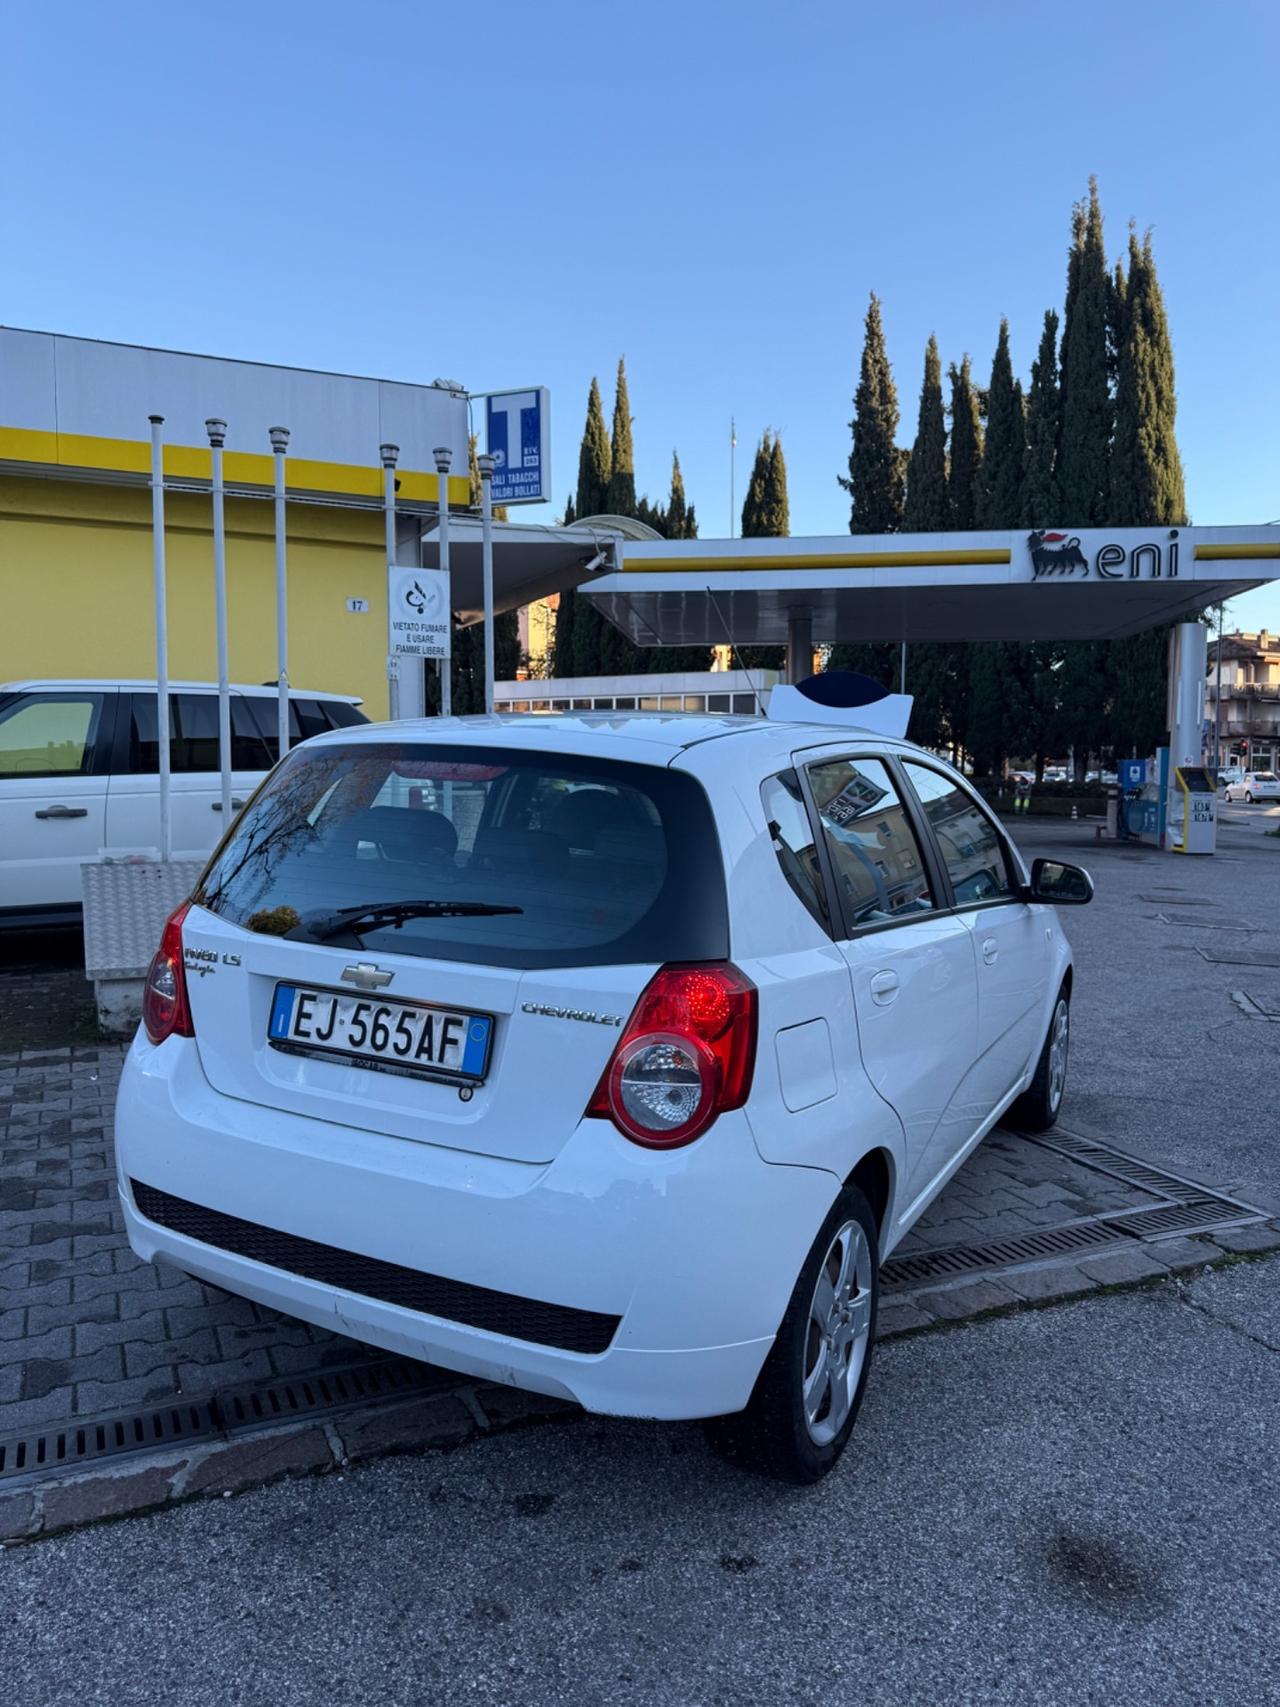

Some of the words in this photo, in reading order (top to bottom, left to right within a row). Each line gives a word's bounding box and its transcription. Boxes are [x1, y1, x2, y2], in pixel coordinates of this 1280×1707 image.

[491, 392, 537, 469] T
[508, 471, 540, 485] TABACCHI
[514, 484, 541, 497] BOLLATI
[1097, 529, 1180, 579] eni
[352, 599, 364, 611] 17
[393, 622, 420, 632] VIETATO
[420, 623, 448, 634] FUMARE
[406, 633, 412, 643] E
[412, 634, 435, 644] USARE
[396, 644, 422, 655] FIAMME
[422, 646, 446, 656] LIBERE
[223, 952, 242, 967] LS
[521, 1001, 625, 1028] CHEVROLET
